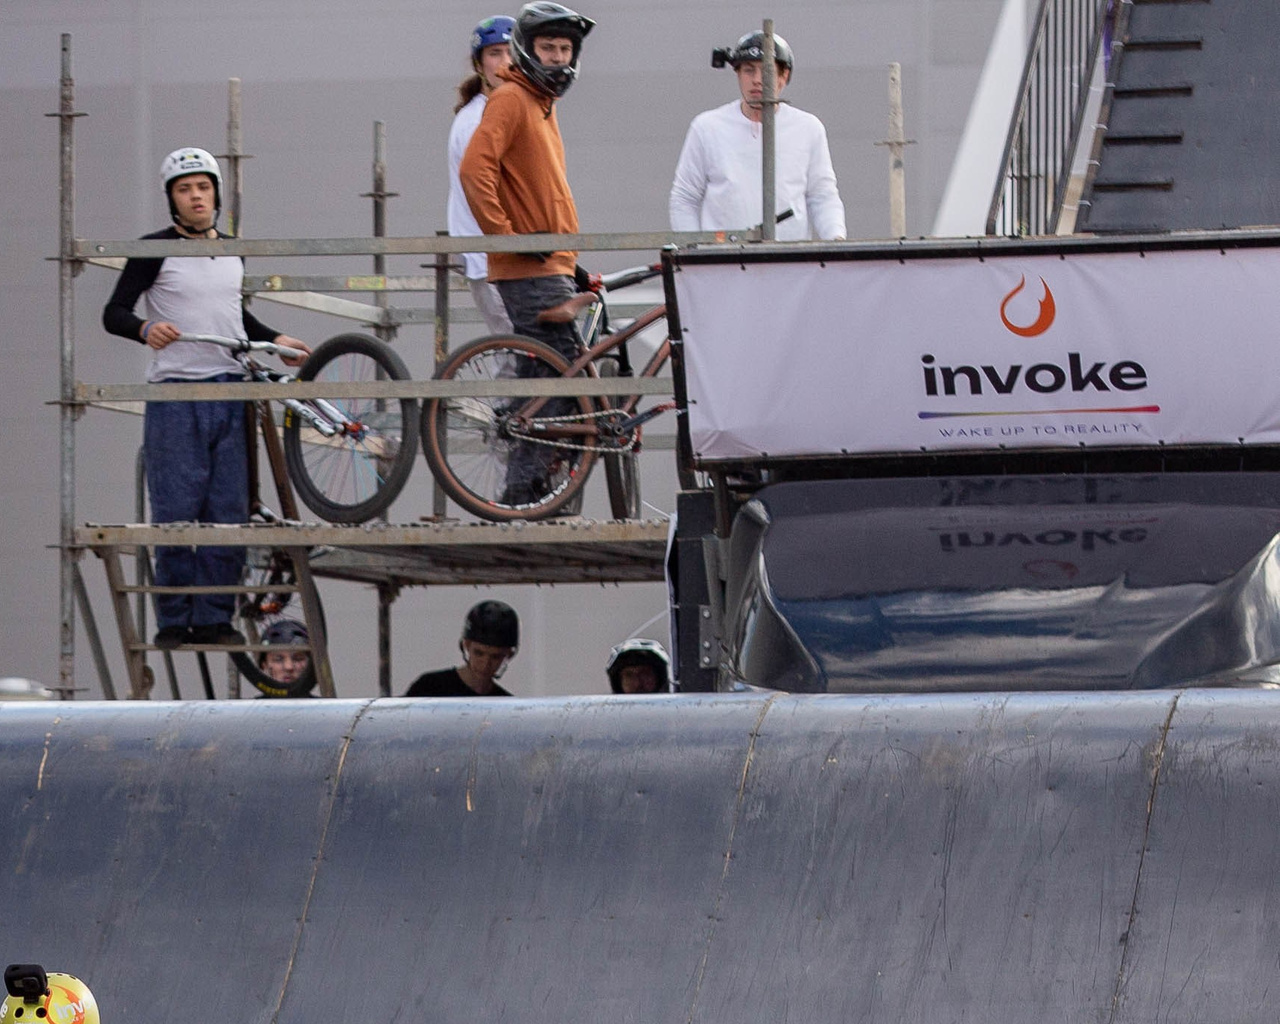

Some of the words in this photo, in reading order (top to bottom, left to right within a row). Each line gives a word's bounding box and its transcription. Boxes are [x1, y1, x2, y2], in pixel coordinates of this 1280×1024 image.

[921, 351, 1148, 398] invoke
[938, 427, 994, 438] WAKE
[1000, 426, 1025, 435] UP
[1033, 425, 1057, 435] TO
[1064, 423, 1144, 434] REALITY
